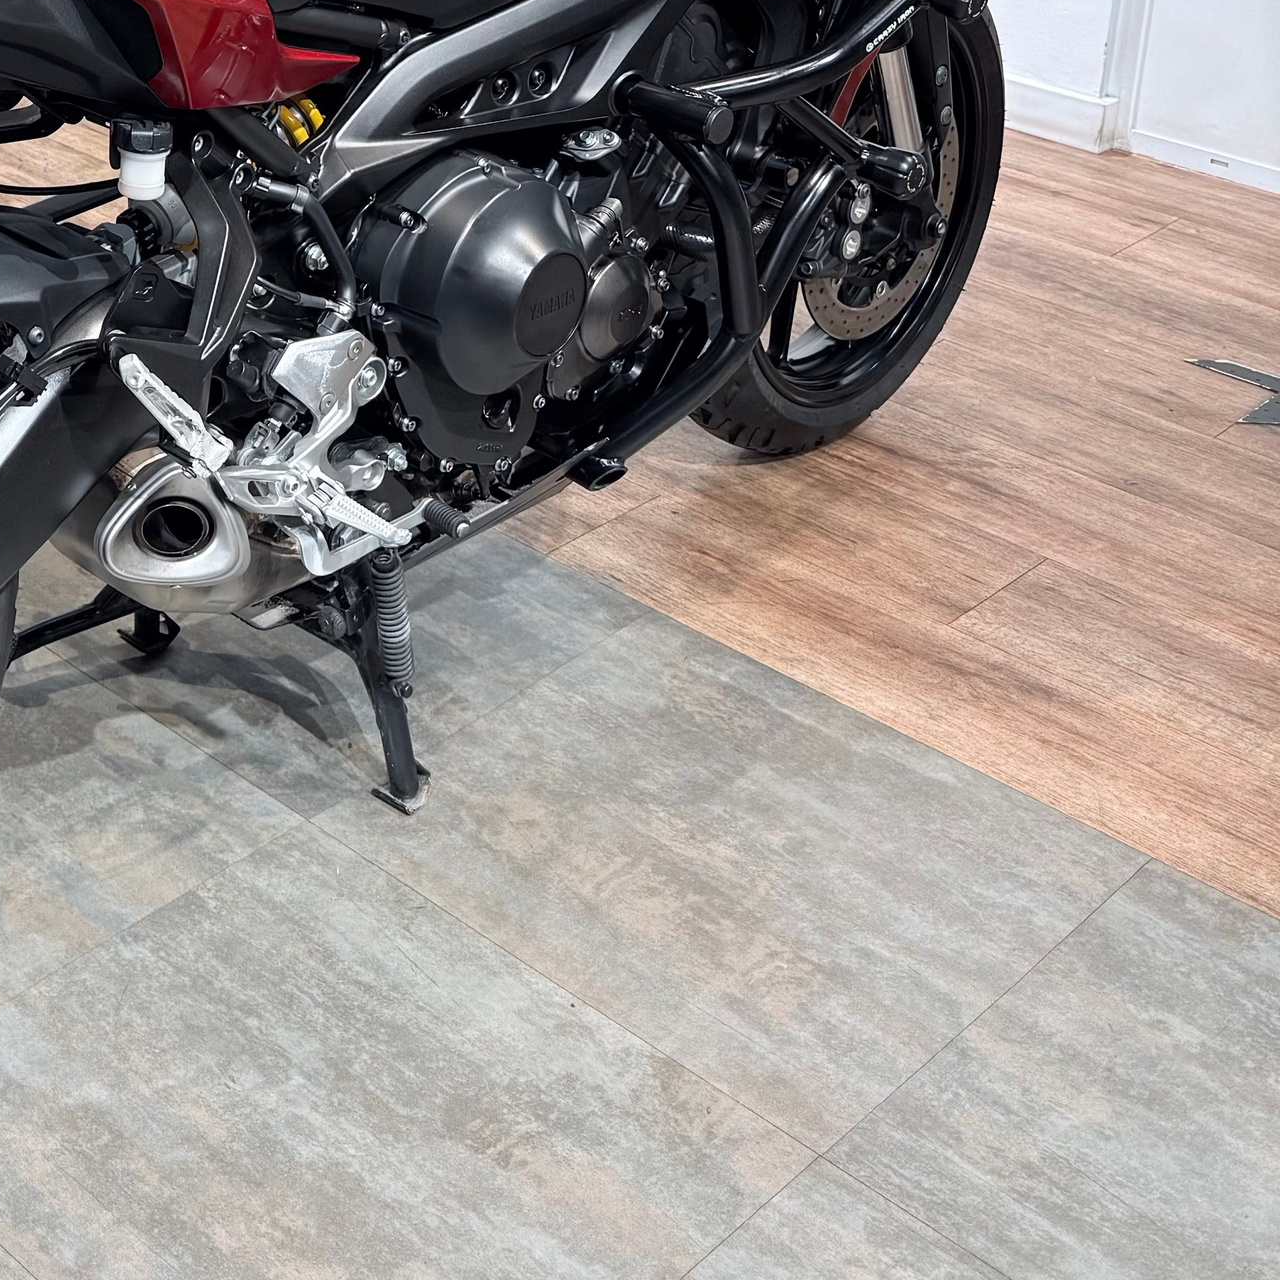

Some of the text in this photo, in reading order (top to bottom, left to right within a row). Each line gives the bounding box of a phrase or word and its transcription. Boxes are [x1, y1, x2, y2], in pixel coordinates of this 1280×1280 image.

[873, 5, 915, 46] CRAZY IRON
[529, 287, 576, 321] YAMAHA
